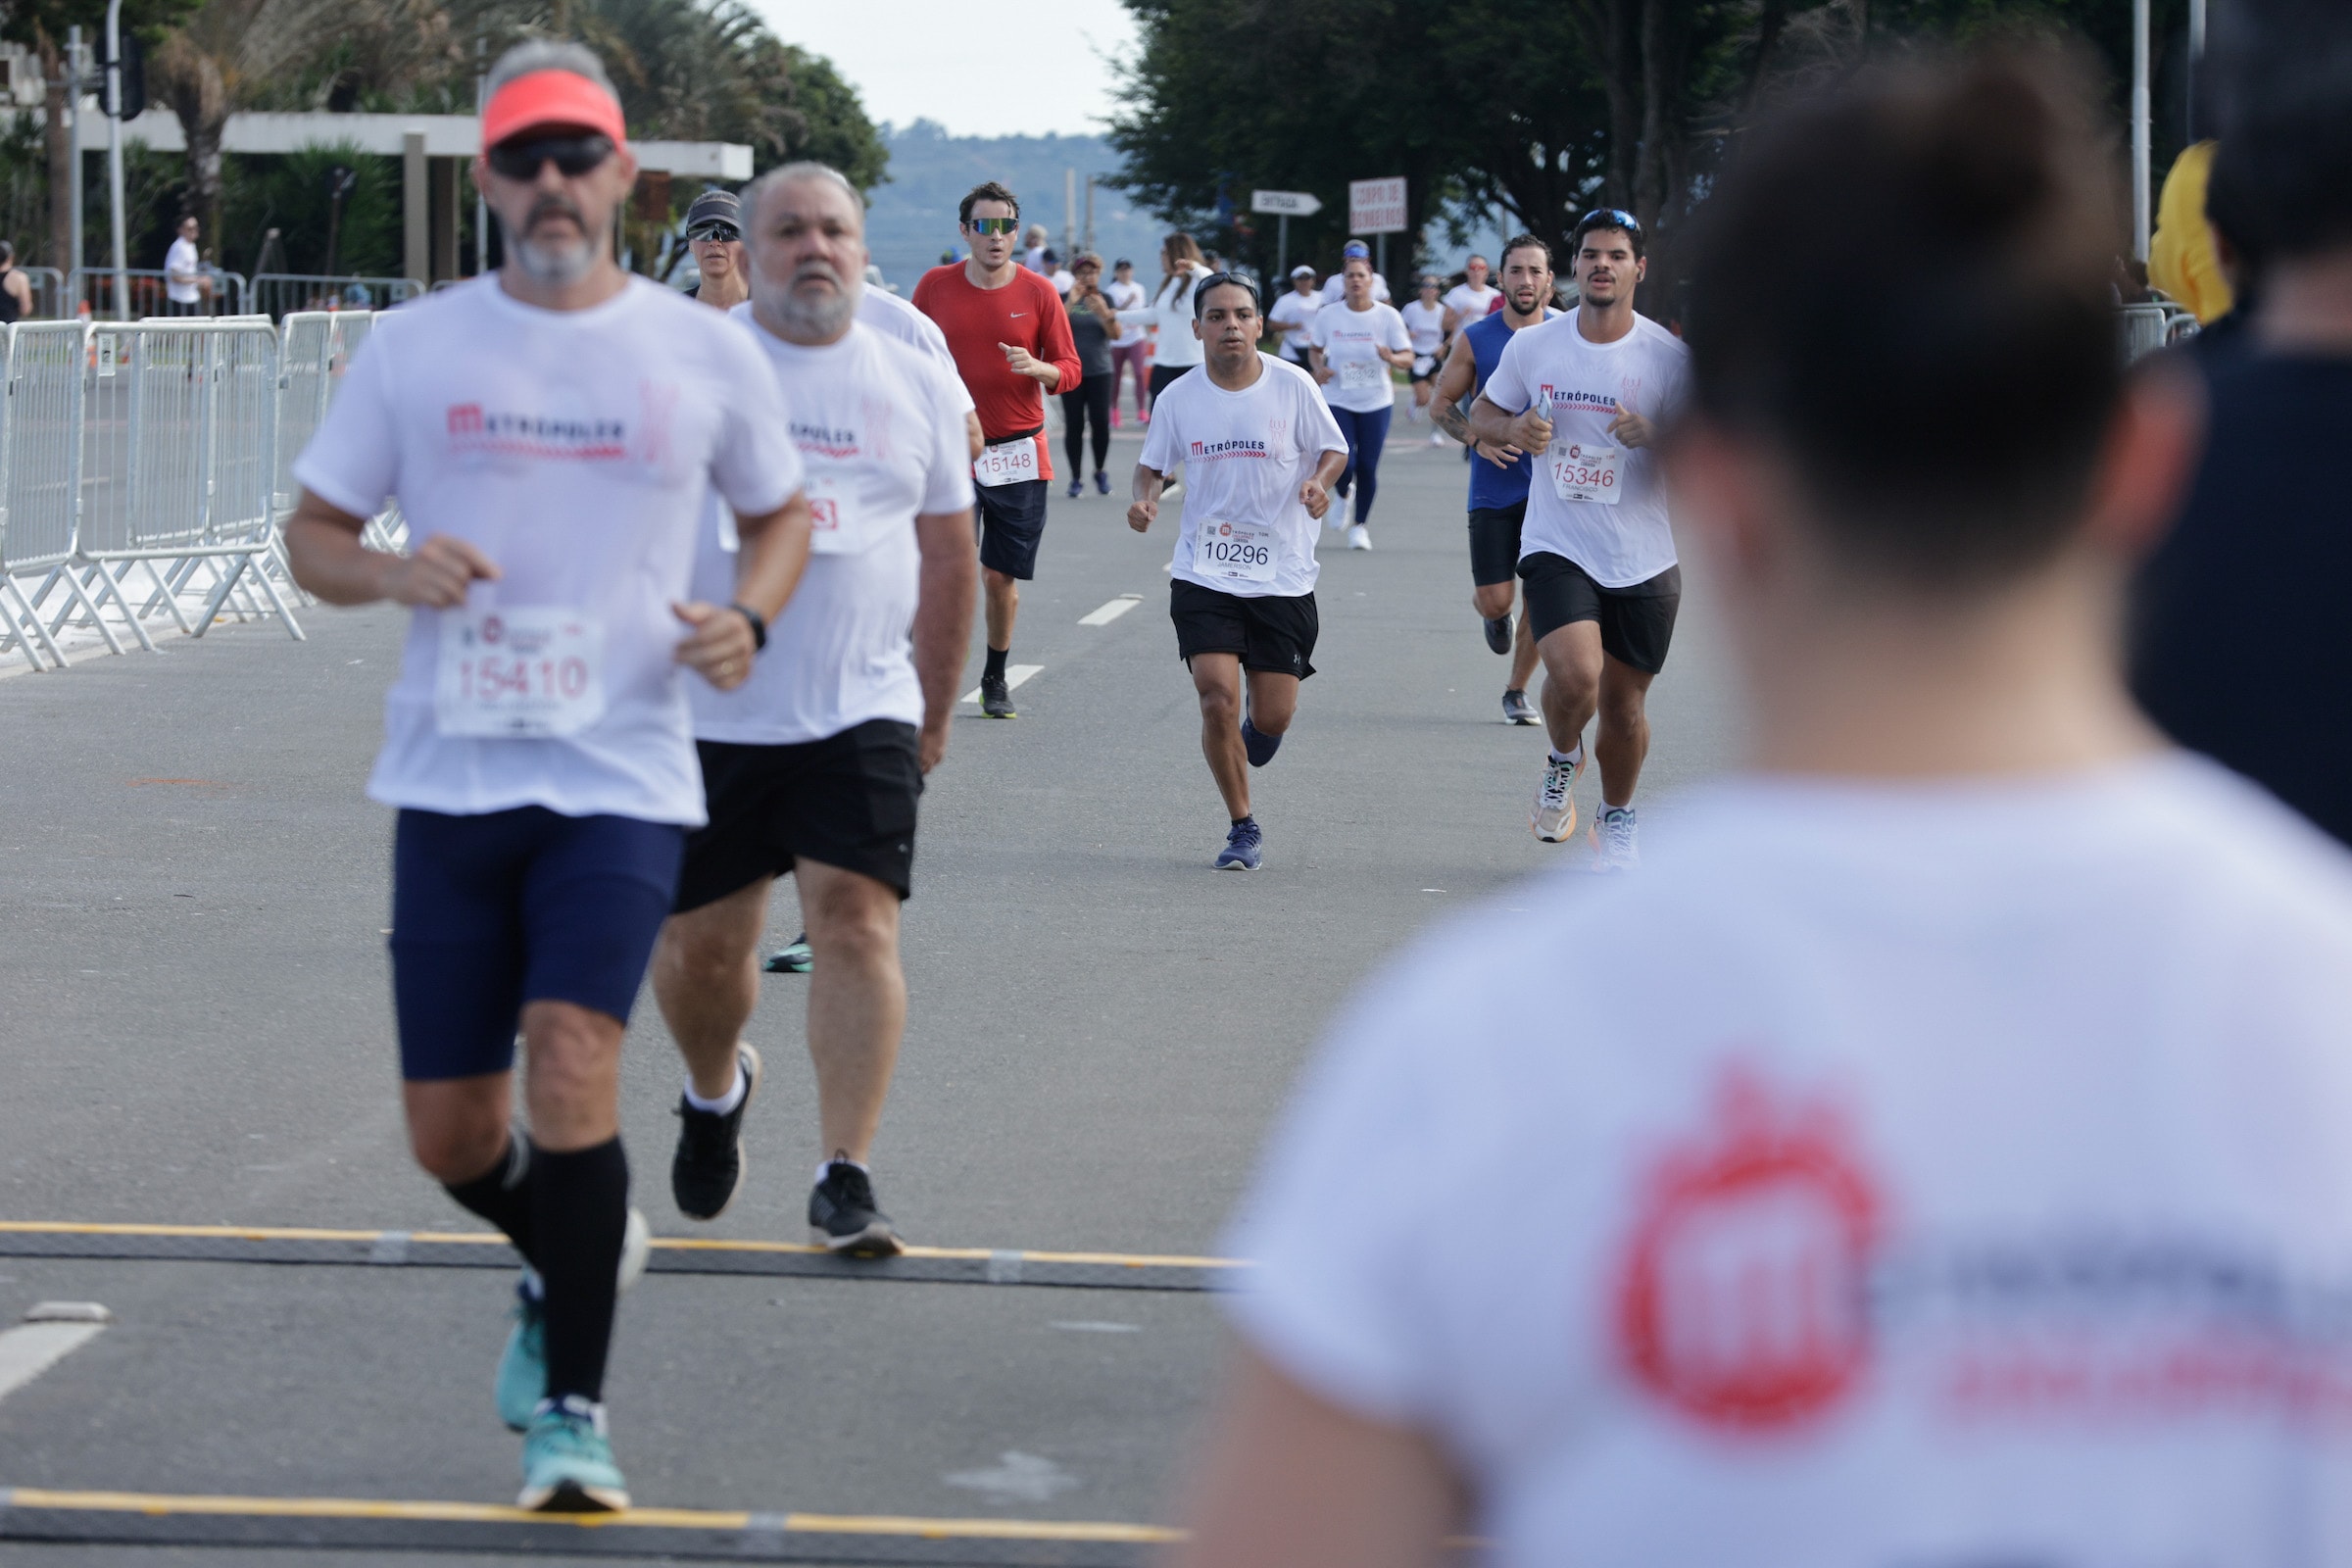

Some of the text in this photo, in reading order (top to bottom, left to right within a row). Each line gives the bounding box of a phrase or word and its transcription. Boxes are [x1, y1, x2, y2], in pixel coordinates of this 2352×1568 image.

[1541, 383, 1616, 406] METRÓPOLES
[1191, 440, 1265, 456] METRÓPOLES
[981, 453, 1031, 473] 15148
[1554, 462, 1615, 487] 15346
[1562, 483, 1598, 493] FRANCISCO
[1204, 540, 1269, 565] 10296
[1217, 562, 1252, 570] JAMERSON
[460, 656, 588, 701] 15410
